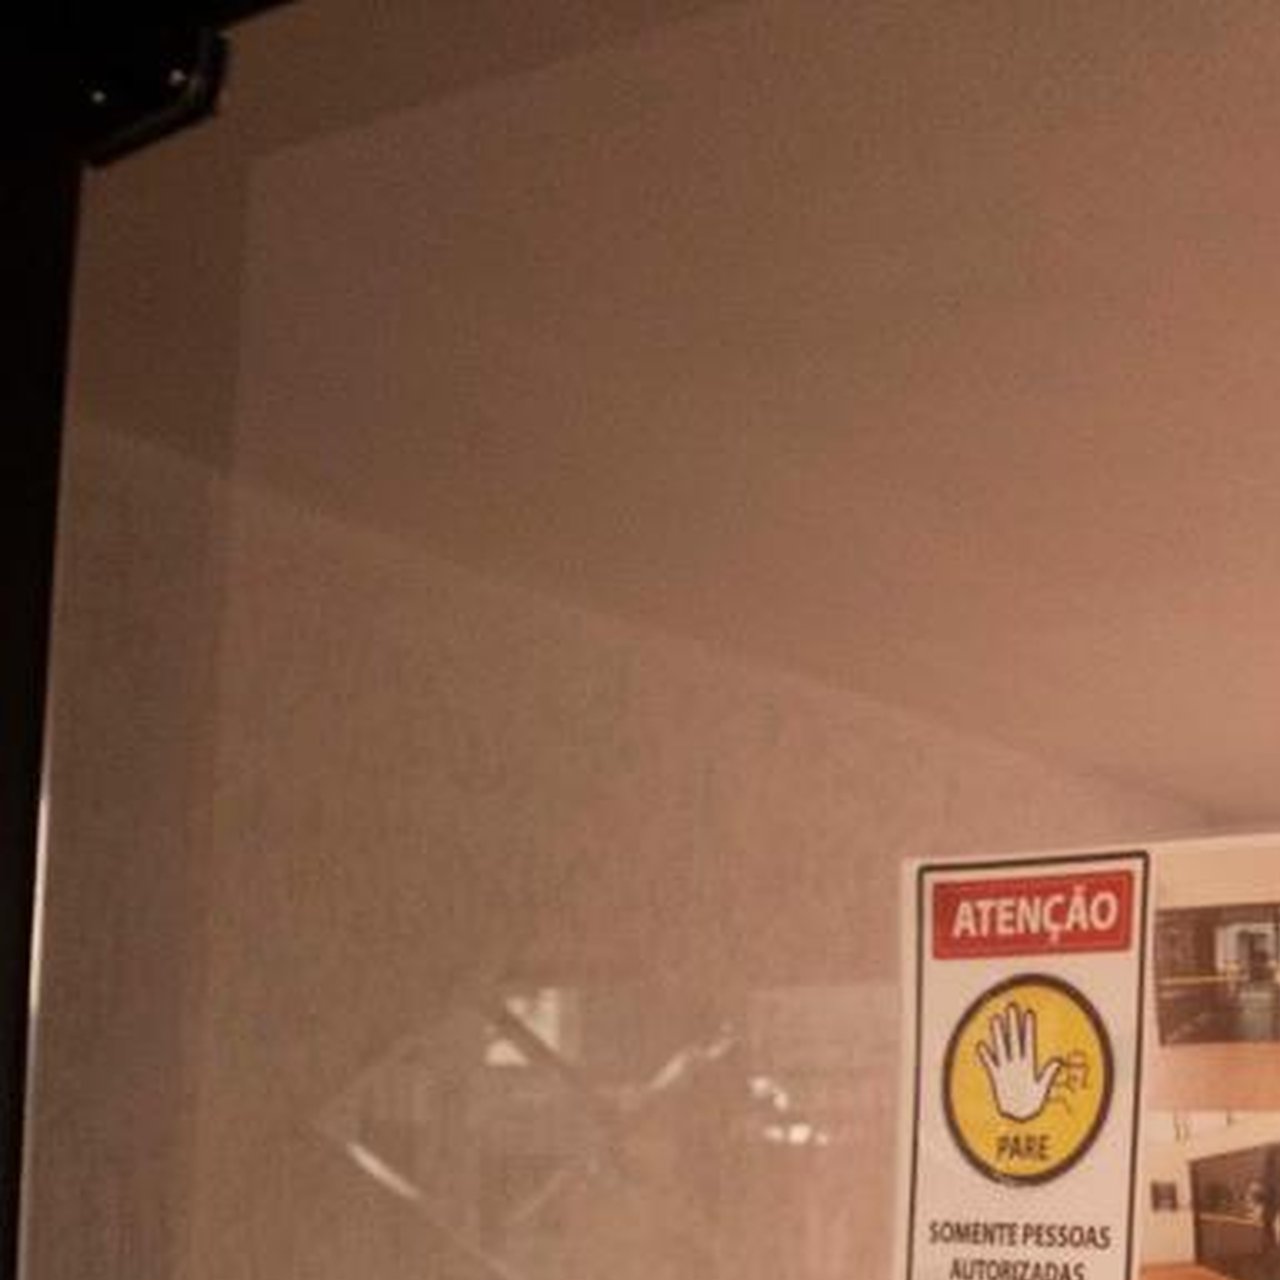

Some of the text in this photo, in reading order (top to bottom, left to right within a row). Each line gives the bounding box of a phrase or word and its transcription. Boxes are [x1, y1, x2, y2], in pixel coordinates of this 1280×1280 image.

[953, 884, 1119, 944] ATENÇÃO
[997, 1134, 1050, 1161] PARE
[930, 1221, 1111, 1249] SOMENTE PESSOAS
